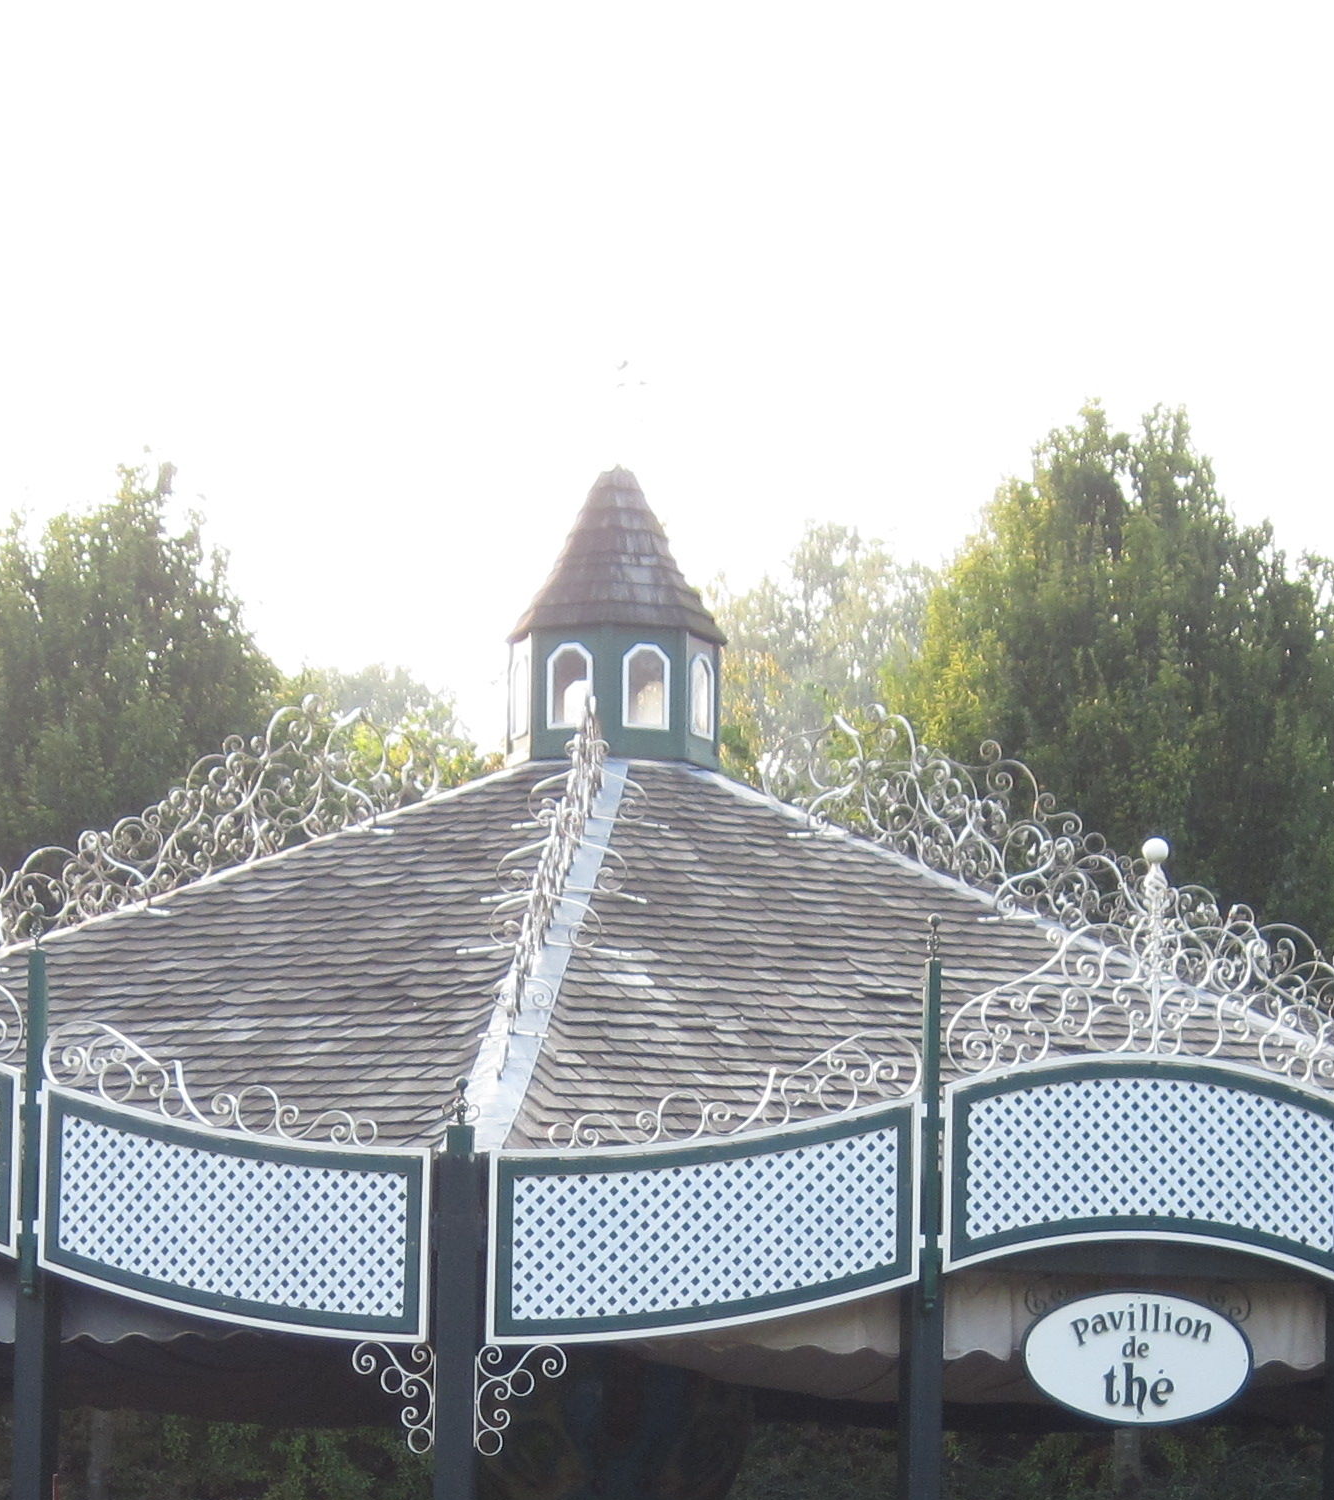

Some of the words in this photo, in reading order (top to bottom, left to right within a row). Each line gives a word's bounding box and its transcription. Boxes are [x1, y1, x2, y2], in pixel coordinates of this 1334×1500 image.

[1070, 1303, 1212, 1346] pavillion
[1121, 1336, 1150, 1358] de
[1103, 1362, 1174, 1415] thé
